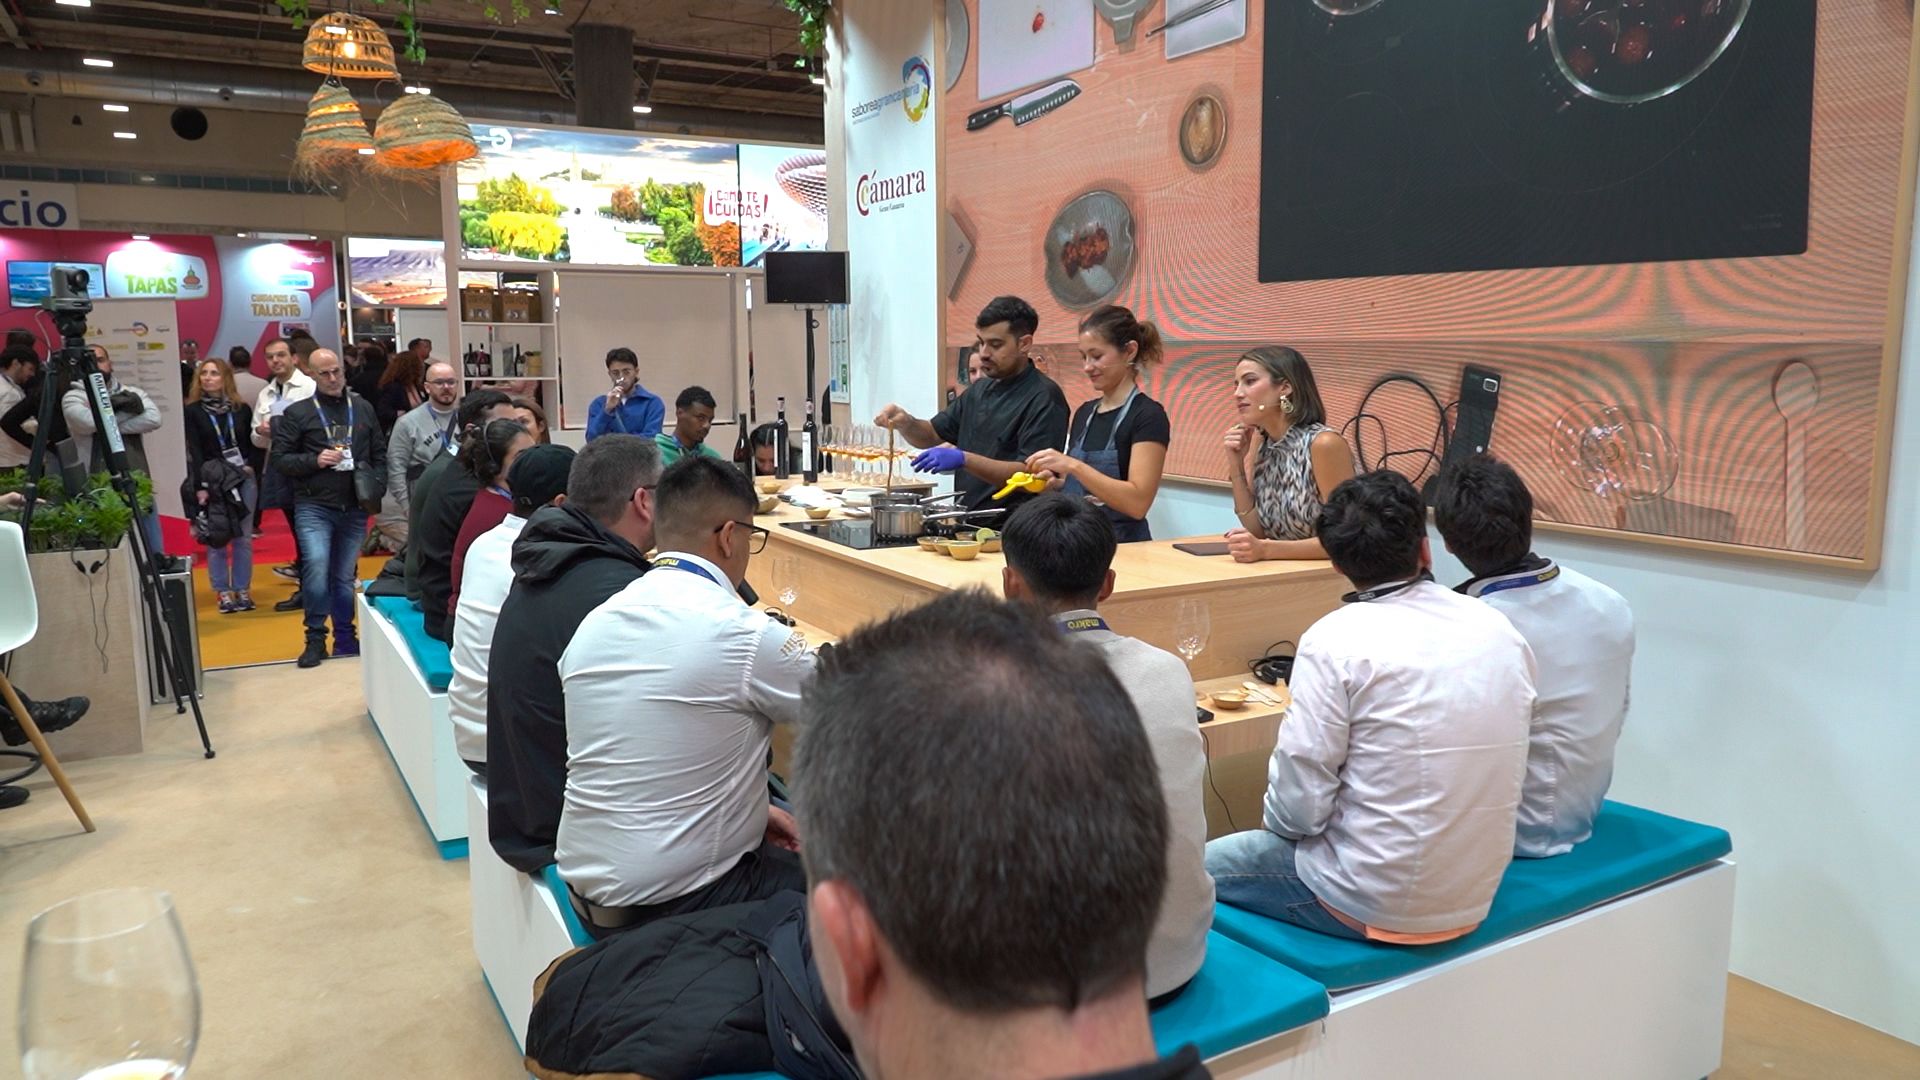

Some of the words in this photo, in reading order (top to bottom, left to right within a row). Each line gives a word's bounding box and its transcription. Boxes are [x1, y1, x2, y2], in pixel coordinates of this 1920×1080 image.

[856, 169, 926, 217] Cámara
[125, 274, 178, 294] TAPAS
[251, 303, 302, 317] TALENTO
[1067, 618, 1100, 630] makro
